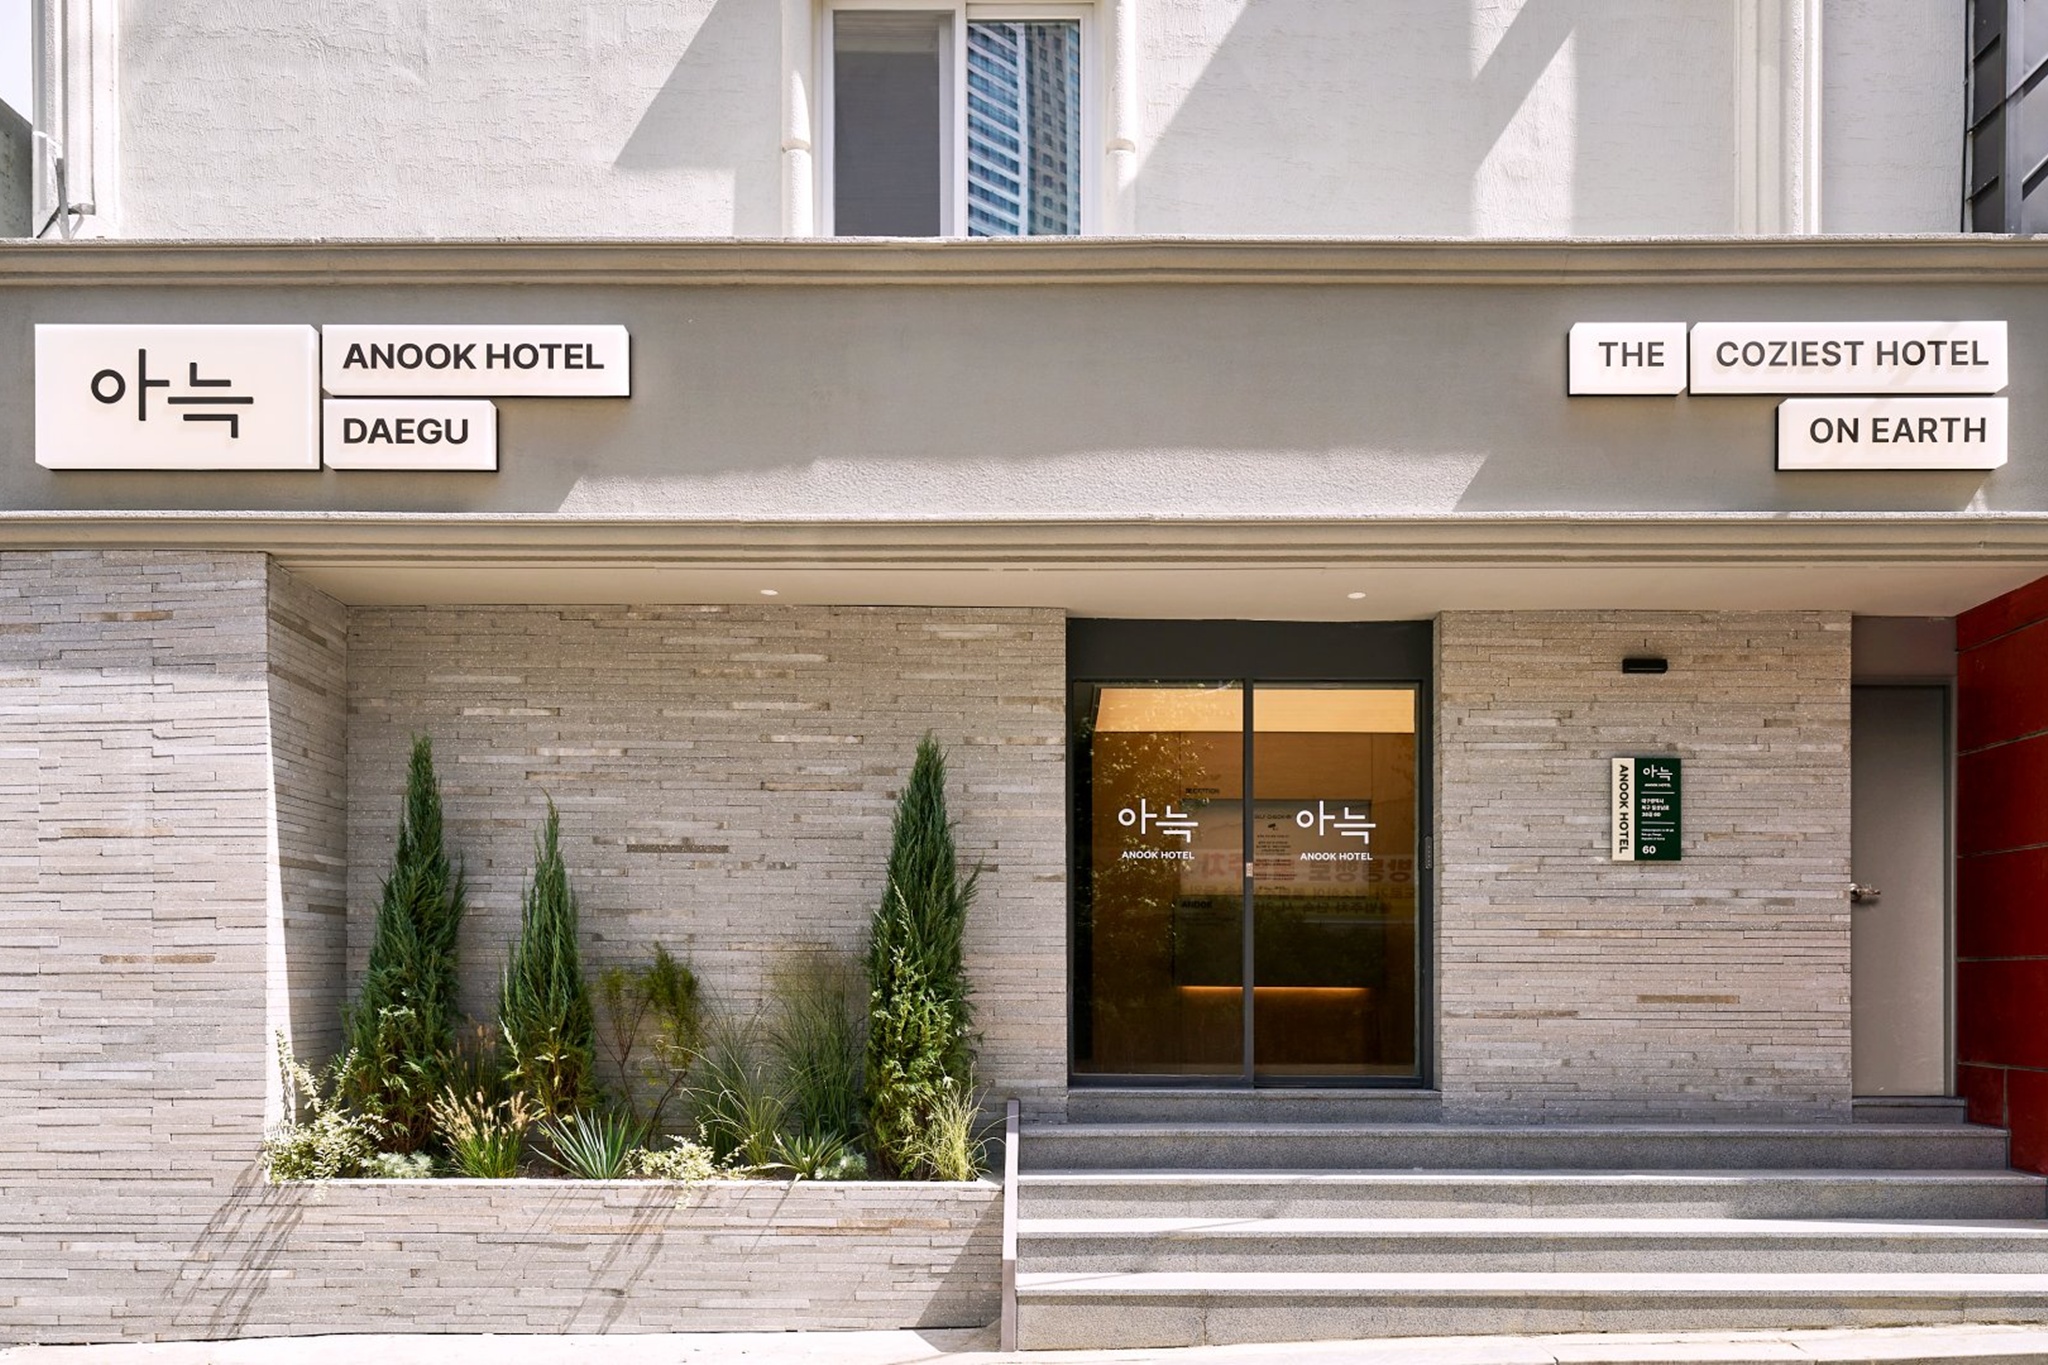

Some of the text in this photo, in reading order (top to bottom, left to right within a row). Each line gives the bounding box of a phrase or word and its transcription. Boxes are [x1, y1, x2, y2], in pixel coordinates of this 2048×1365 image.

[343, 343, 605, 370] ANOOK HOTEL
[1598, 340, 1989, 367] THE COZIEST HOTEL
[90, 348, 254, 439] 아늑
[343, 418, 468, 445] DAEGU
[1809, 417, 1986, 444] ON EARTH
[1642, 764, 1673, 781] 아늑
[1118, 798, 1199, 843] 아늑
[1296, 800, 1376, 844] 아늑
[1619, 764, 1629, 853] ANOOK HOTEL
[1121, 850, 1195, 860] ANOOK HOTEL
[1300, 852, 1373, 861] ANOOK HOTEL
[1642, 845, 1656, 854] 60
